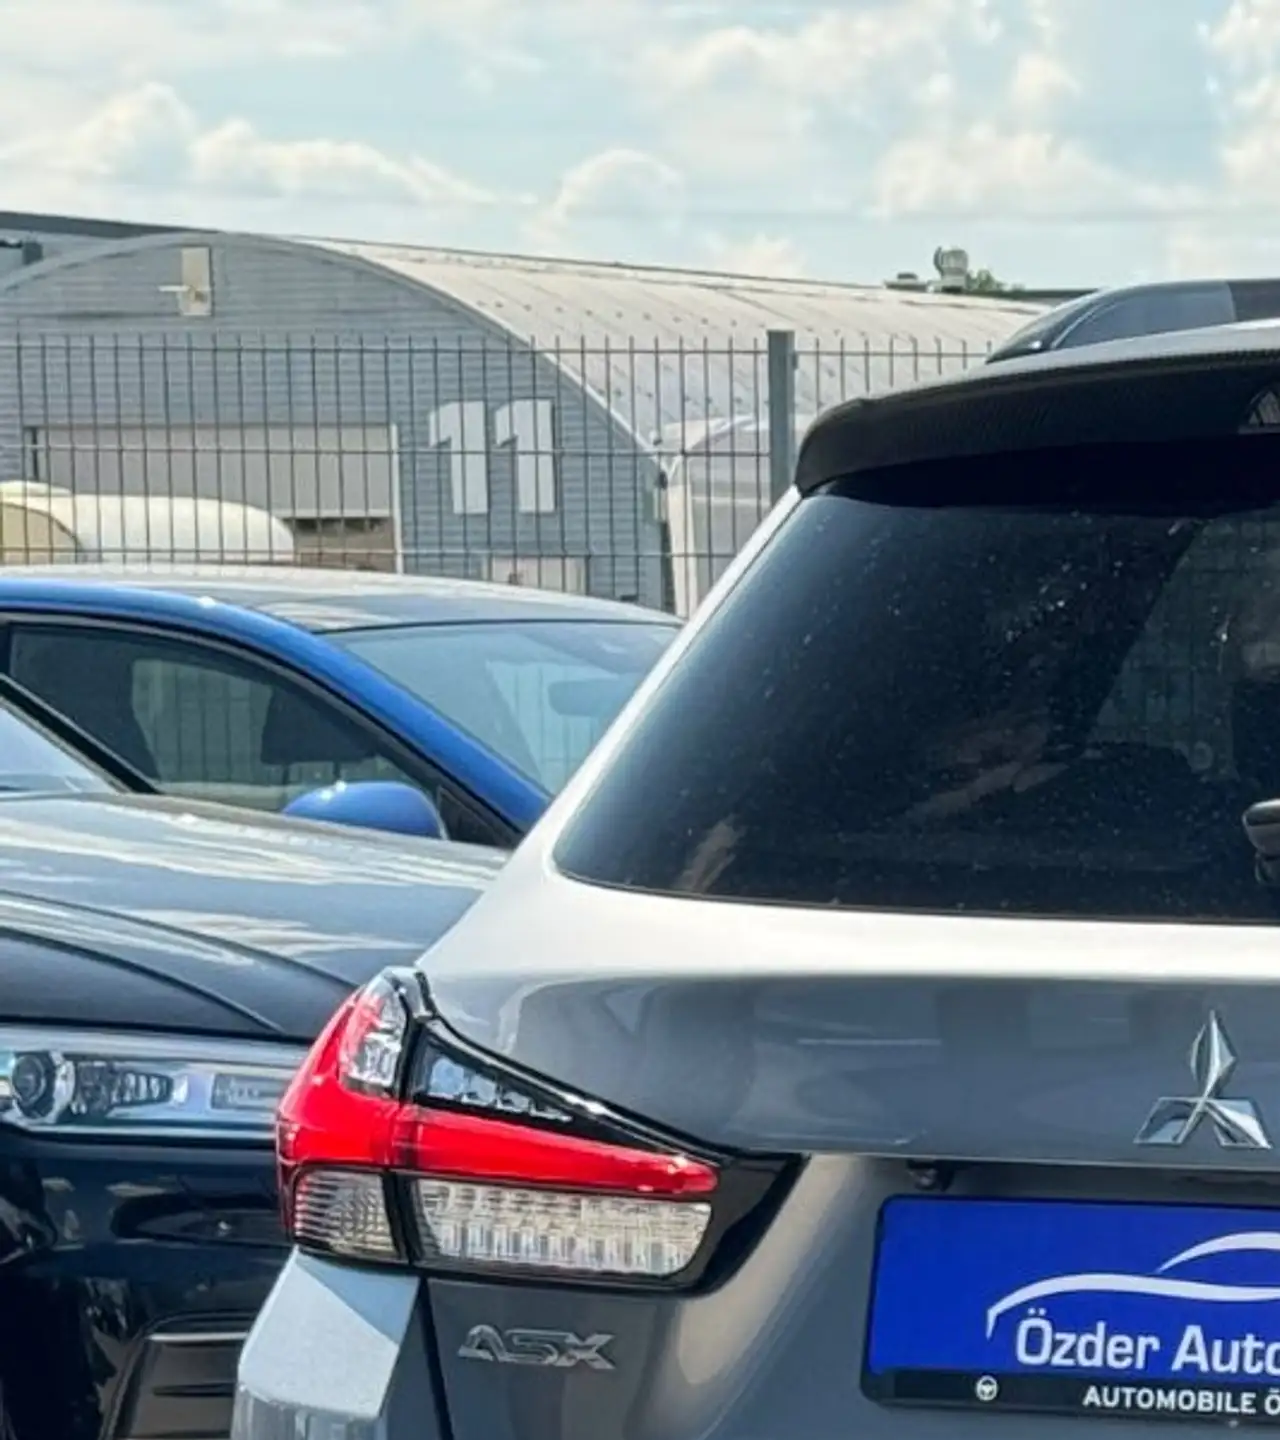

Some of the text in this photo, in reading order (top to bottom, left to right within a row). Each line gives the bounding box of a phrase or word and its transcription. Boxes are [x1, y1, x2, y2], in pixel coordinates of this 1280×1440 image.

[429, 400, 555, 514] 11
[457, 1324, 616, 1370] ASX
[1015, 1308, 1161, 1371] Özder
[1082, 1385, 1256, 1415] AUTOMOBILE
